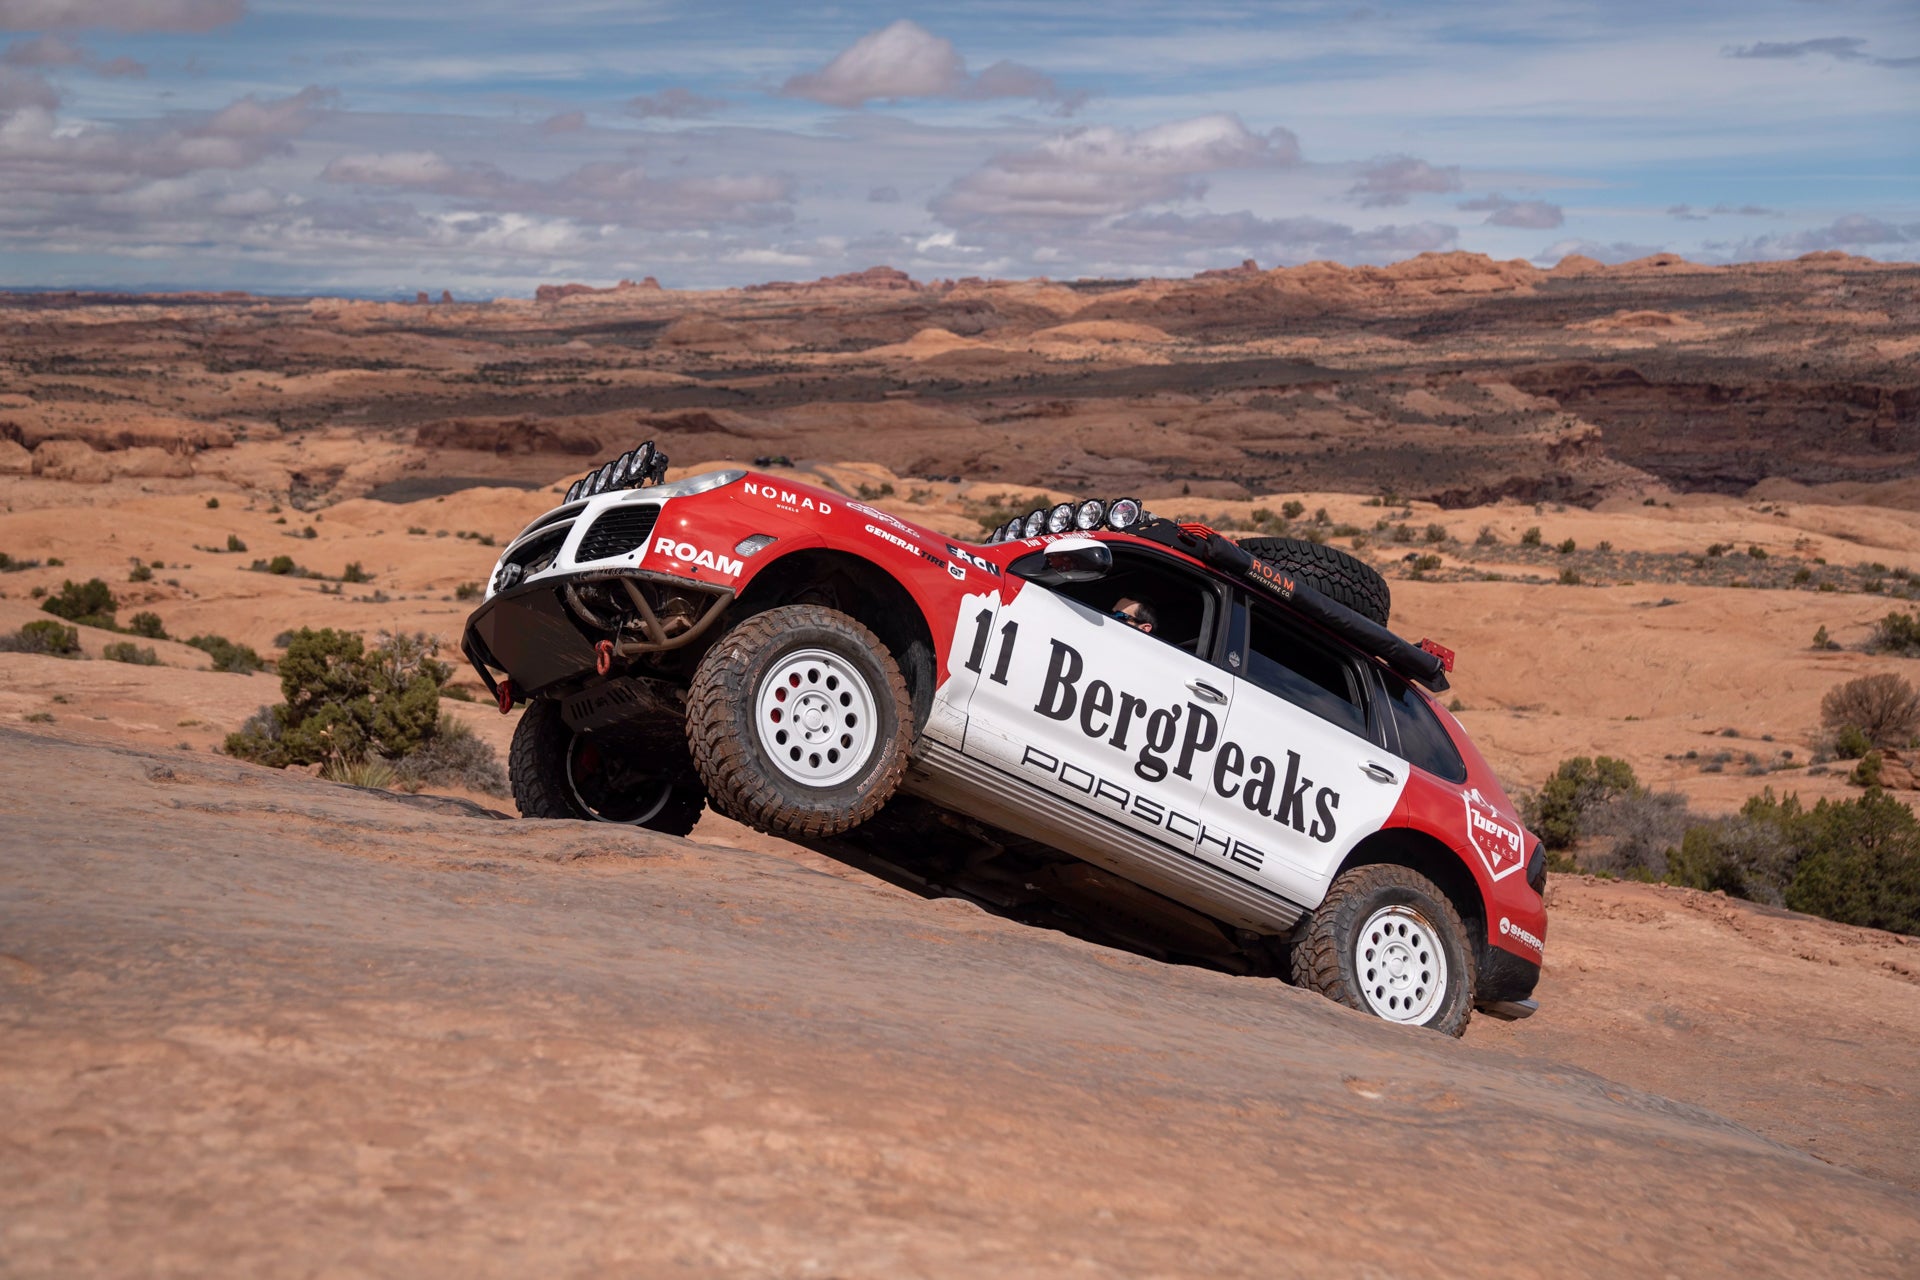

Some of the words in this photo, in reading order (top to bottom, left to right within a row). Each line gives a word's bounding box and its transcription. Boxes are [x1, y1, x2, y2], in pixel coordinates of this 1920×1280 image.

[744, 482, 832, 515] NOMAD
[654, 537, 744, 578] ROAM
[864, 524, 920, 557] GENERAL
[921, 550, 947, 569] TIRE
[1248, 570, 1282, 593] ADVENTURE
[1252, 559, 1295, 592] ROAM
[964, 608, 1019, 687] 11
[1033, 637, 1340, 843] BergPeaks
[1021, 745, 1265, 872] PORSCHE
[1470, 808, 1520, 852] berg
[1480, 835, 1514, 860] PEAKS
